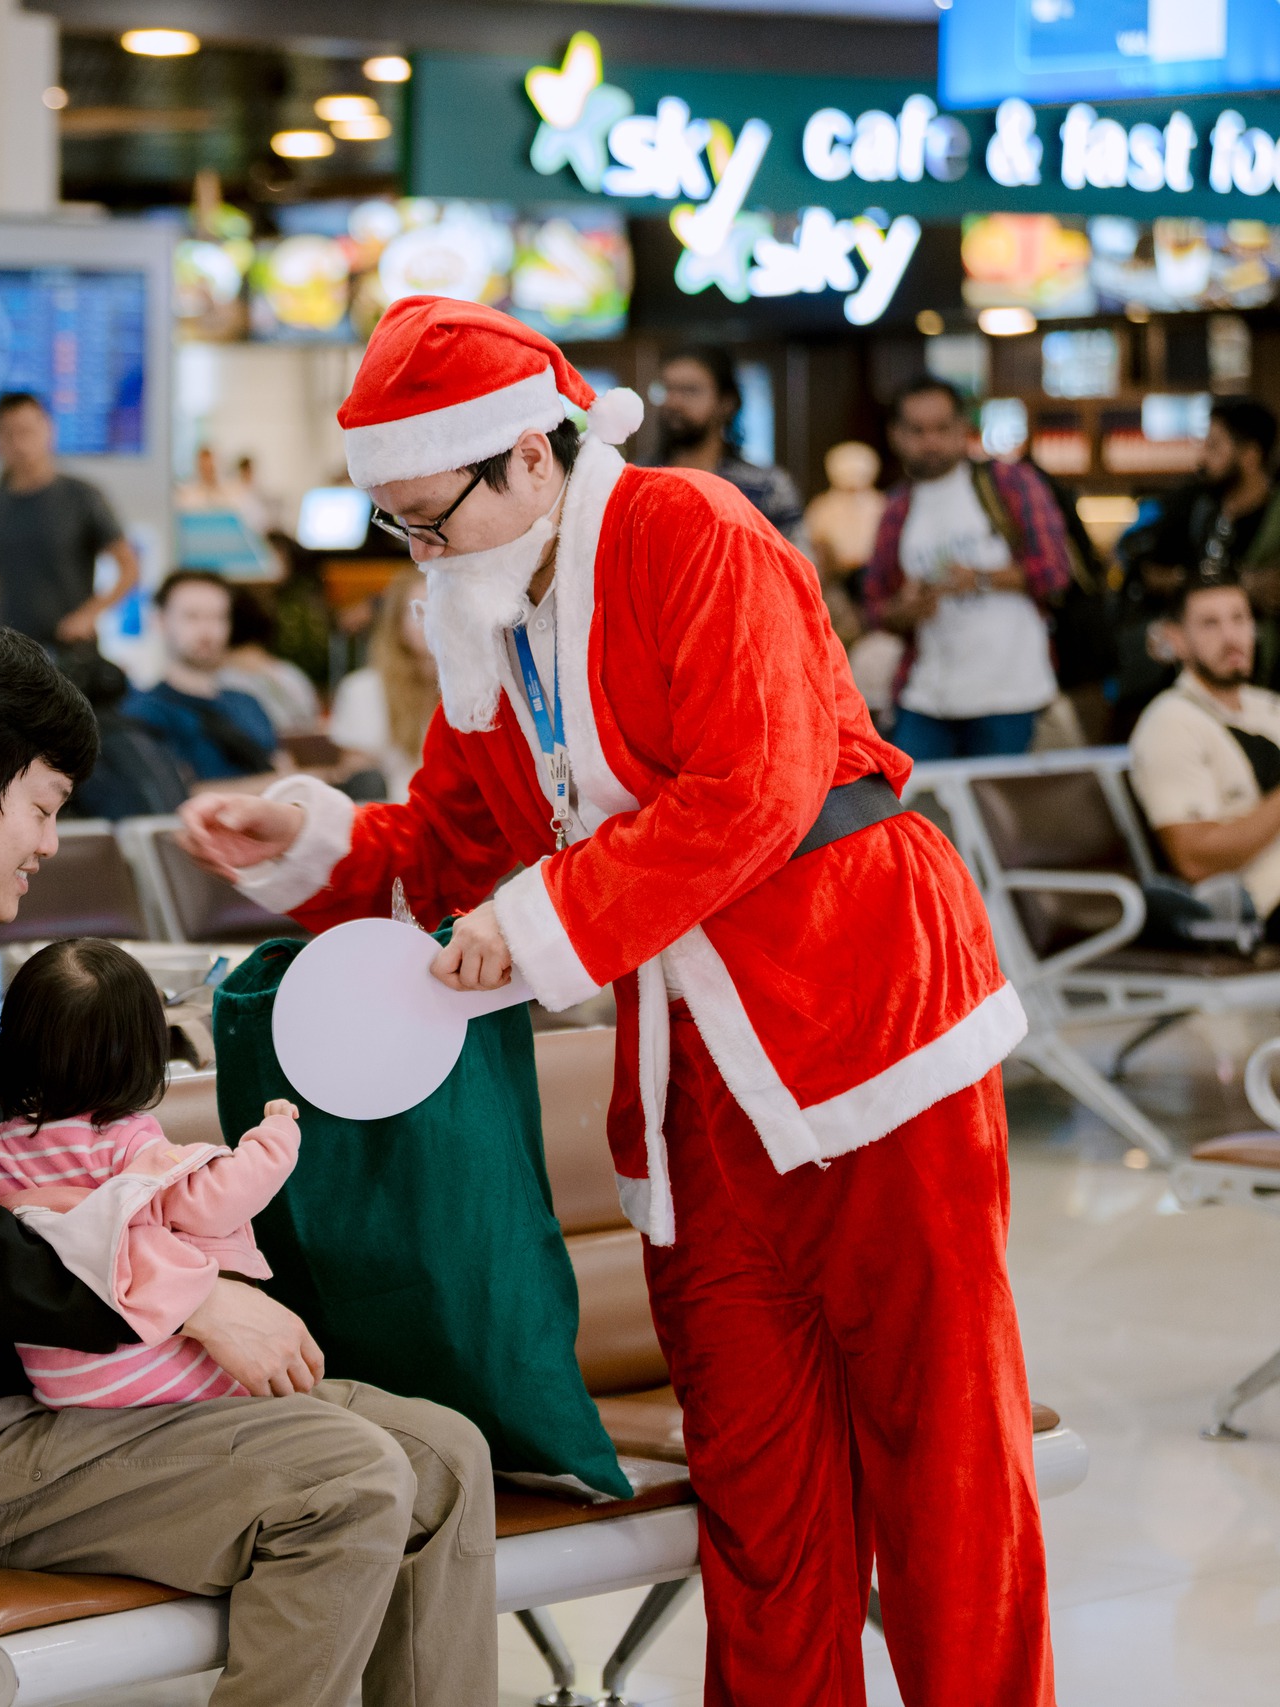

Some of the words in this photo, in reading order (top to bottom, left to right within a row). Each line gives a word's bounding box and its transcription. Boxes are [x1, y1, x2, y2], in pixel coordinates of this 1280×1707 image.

[602, 96, 772, 257] sky
[803, 94, 971, 183] cafe
[986, 97, 1043, 187] &
[1059, 102, 1197, 191] fast
[1209, 109, 1280, 196] fo
[748, 206, 920, 325] sky
[557, 783, 565, 797] NIA
